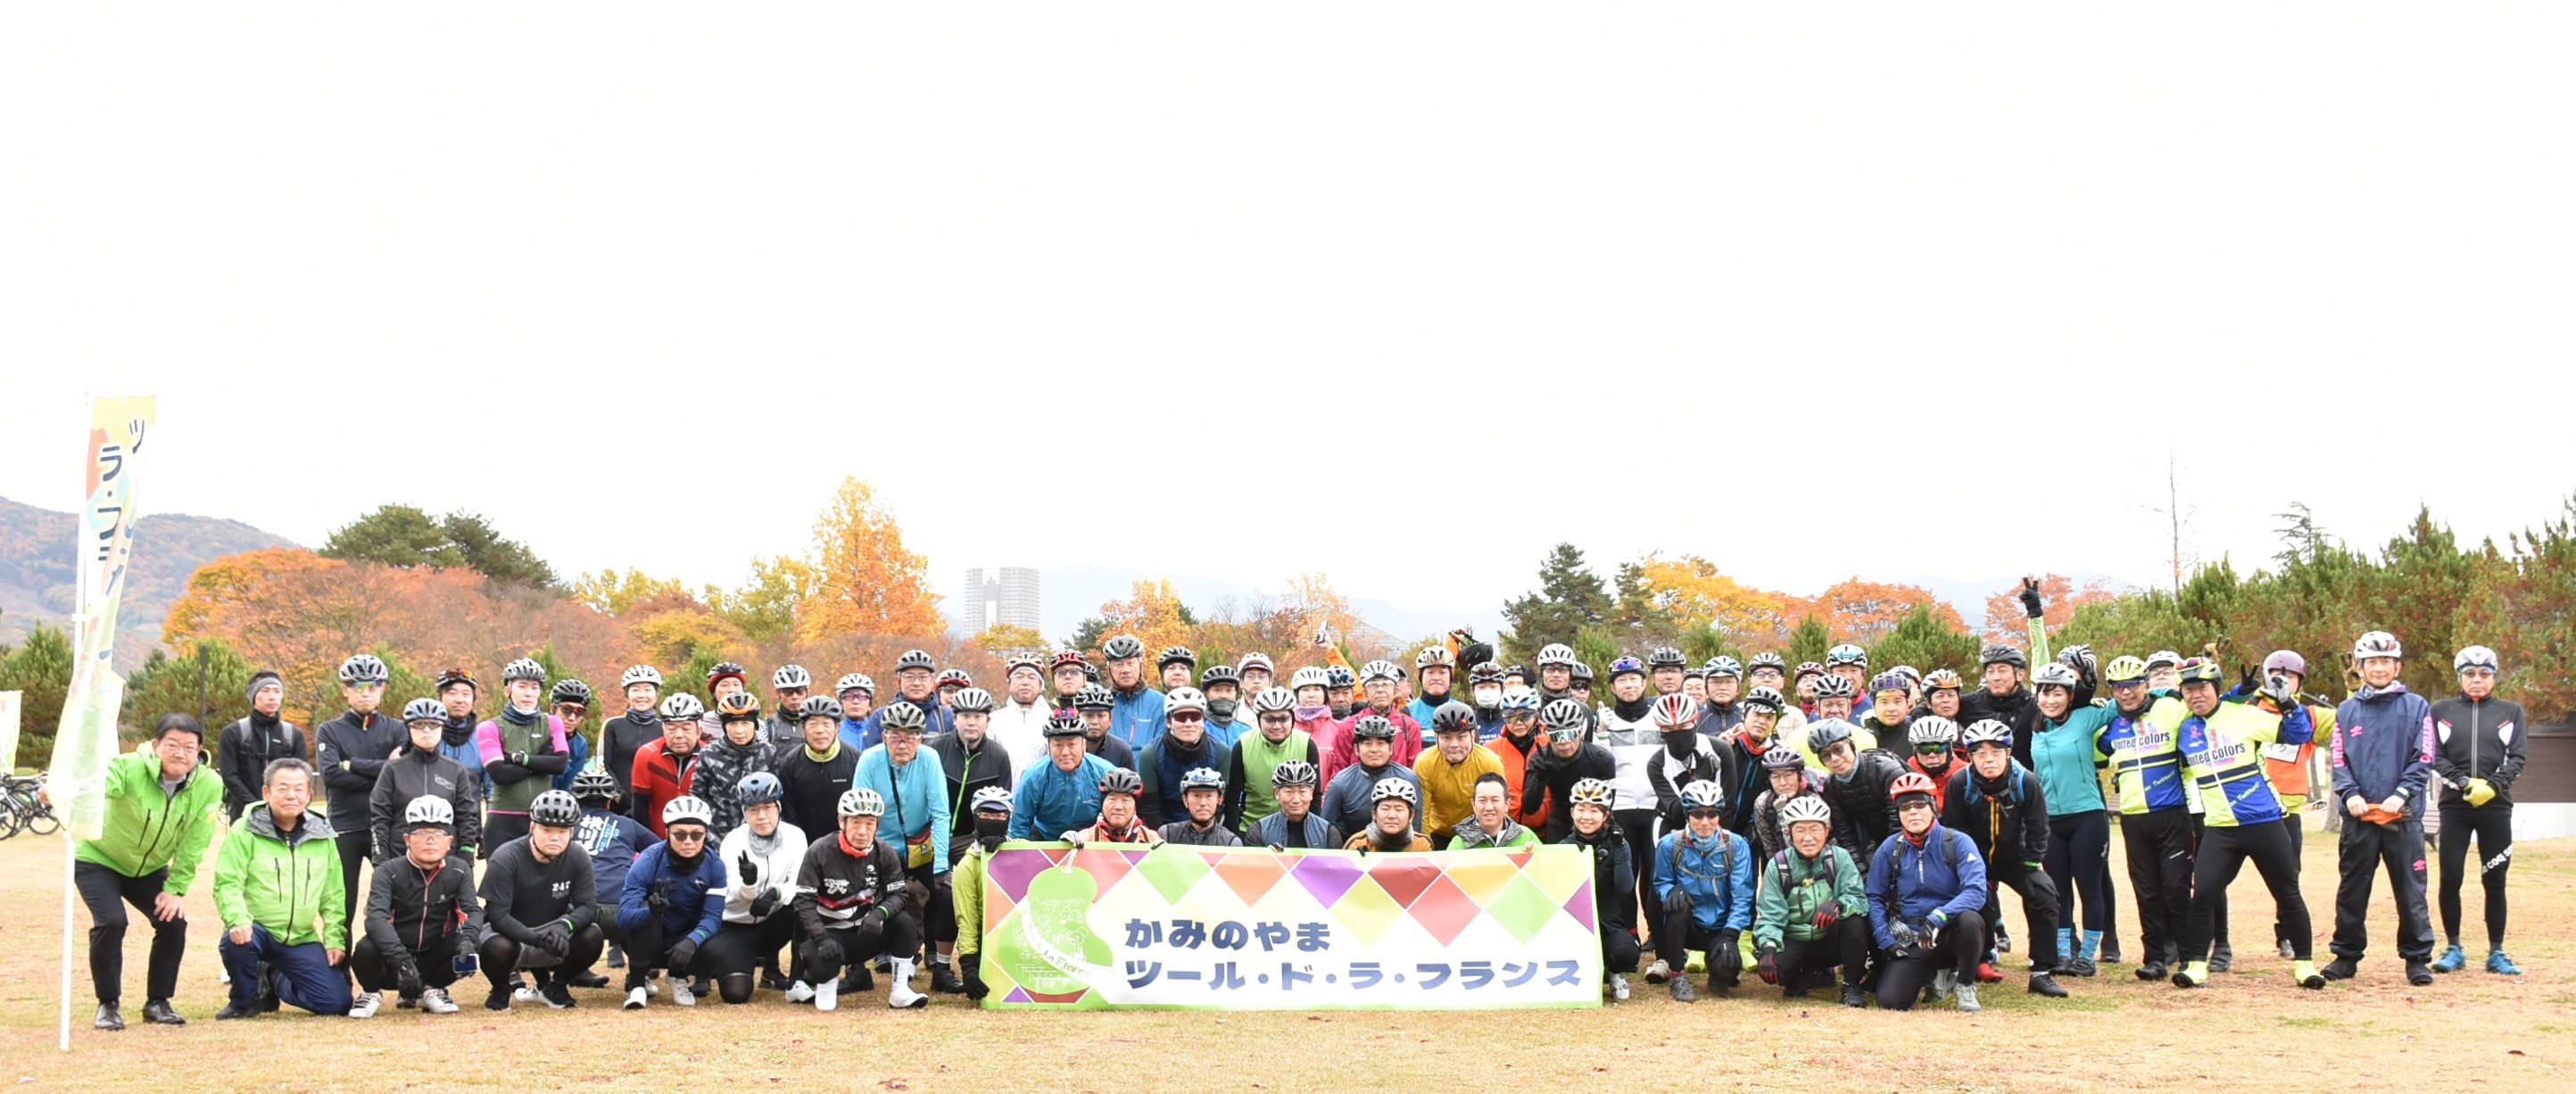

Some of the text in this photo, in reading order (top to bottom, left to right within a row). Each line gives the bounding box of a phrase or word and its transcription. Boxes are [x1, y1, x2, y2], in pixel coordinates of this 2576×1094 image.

[2139, 731, 2171, 747] colors
[2212, 742, 2246, 760] colors
[1125, 918, 1330, 953] かみのやま
[1125, 959, 1581, 991] ツール・ド・ラ・フランス
